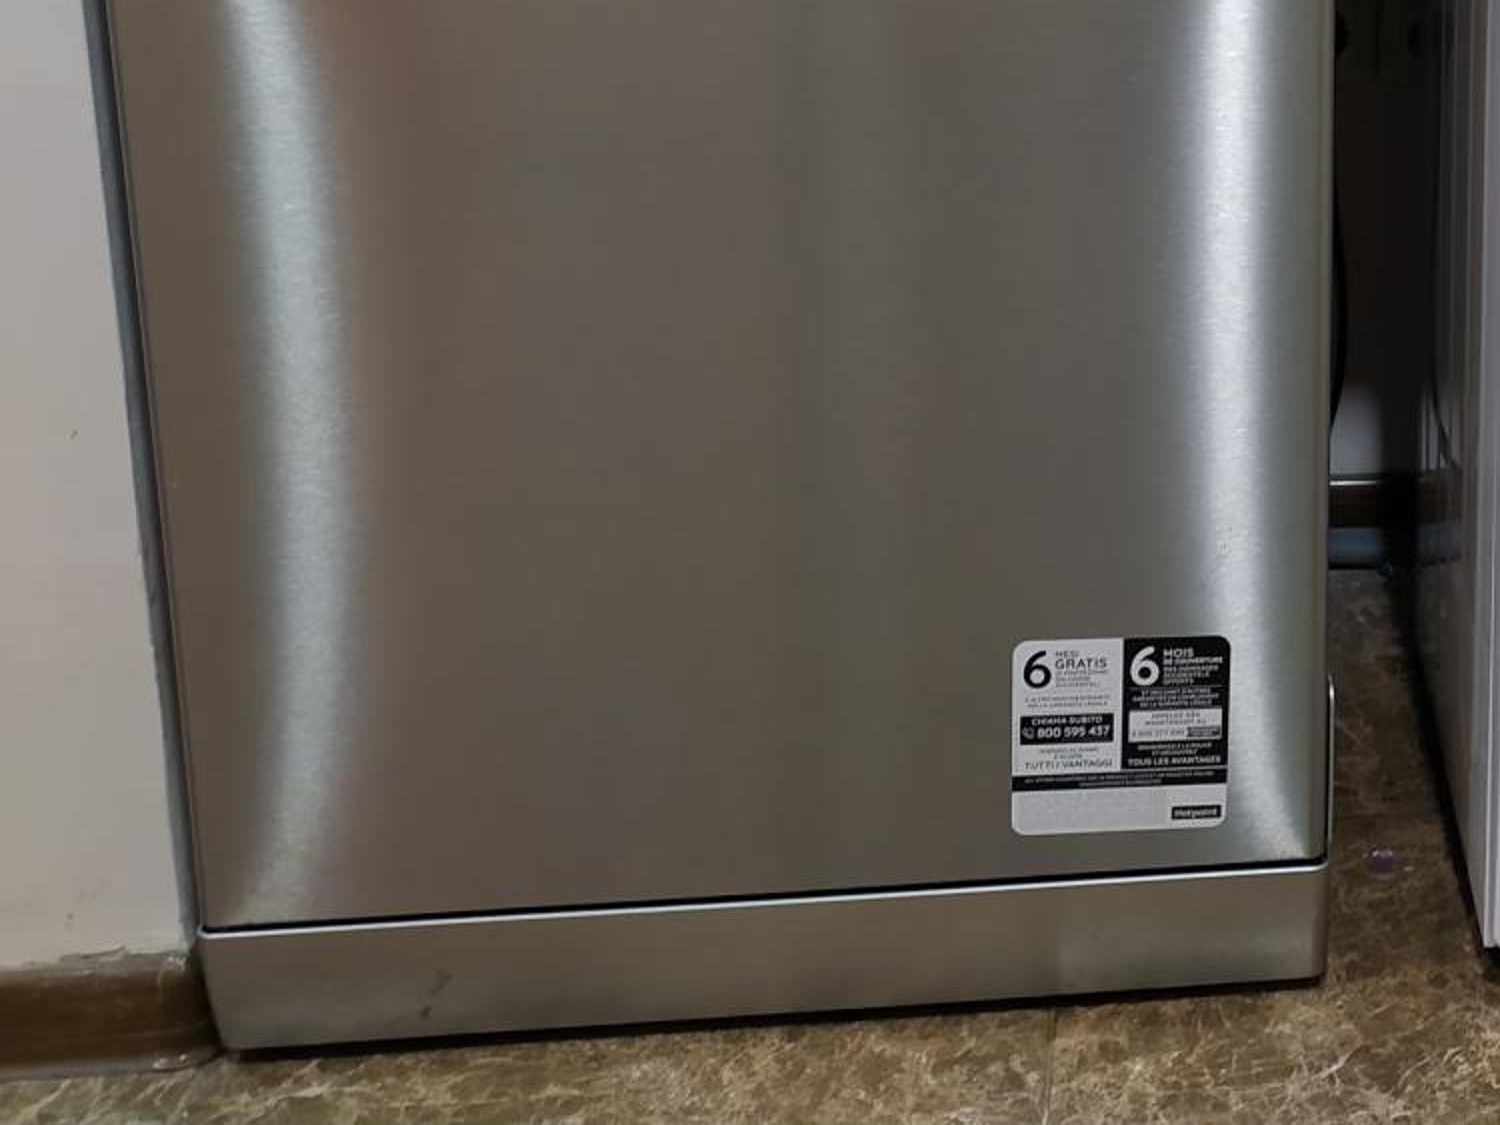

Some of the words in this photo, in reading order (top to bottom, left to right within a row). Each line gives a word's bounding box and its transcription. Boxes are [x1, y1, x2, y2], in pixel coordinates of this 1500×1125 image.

[1023, 650, 1052, 689] 6
[1055, 657, 1108, 670] GRATIS
[1129, 645, 1161, 687] 6
[1163, 648, 1195, 658] MOIS
[1036, 727, 1062, 739] 800
